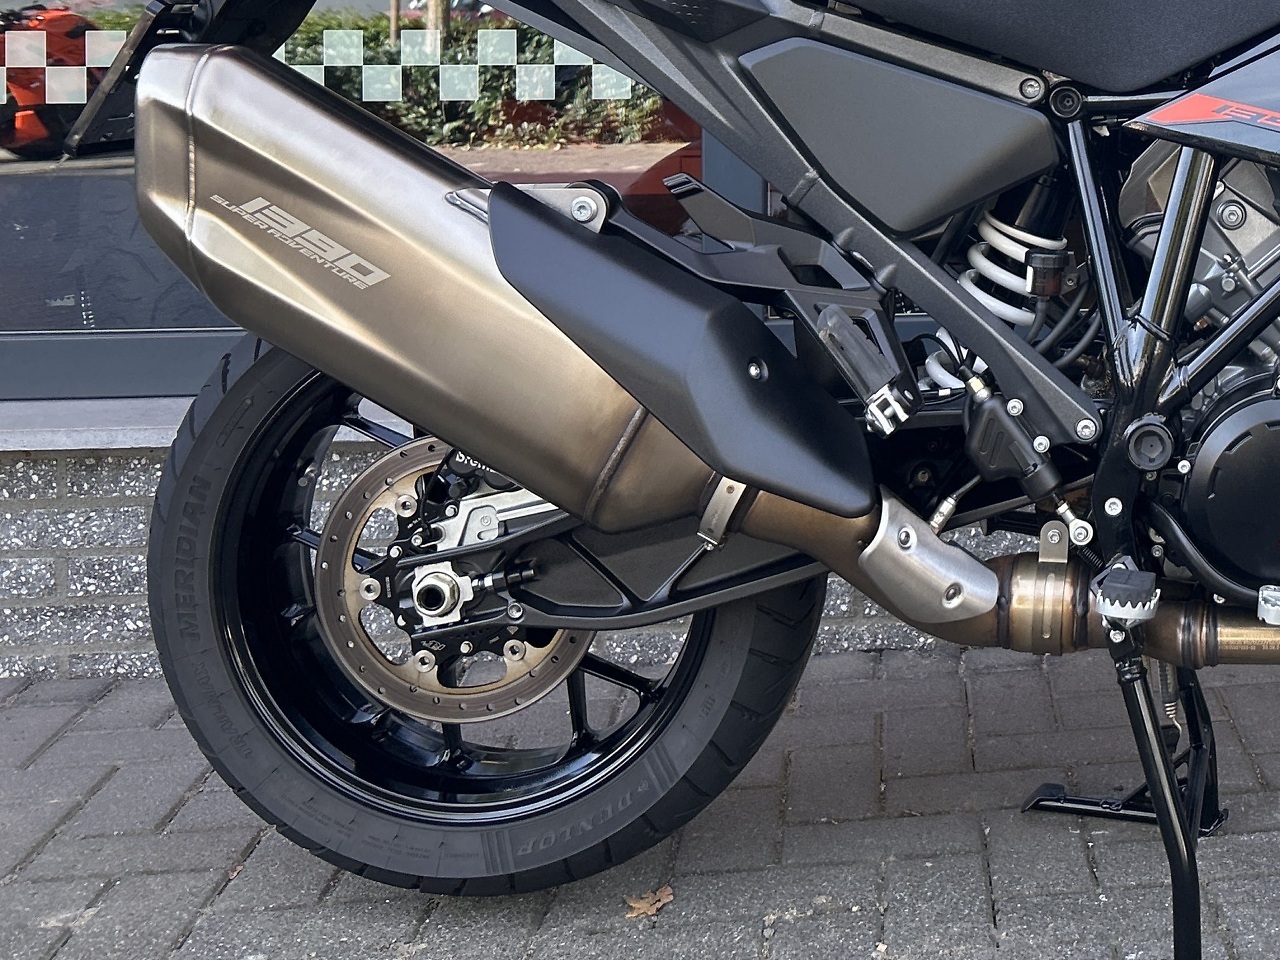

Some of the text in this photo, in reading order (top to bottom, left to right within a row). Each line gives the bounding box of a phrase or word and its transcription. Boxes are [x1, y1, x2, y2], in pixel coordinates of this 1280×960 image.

[210, 194, 369, 290] SUPER ADVENTURE
[239, 196, 392, 287] 1390
[173, 474, 213, 640] MERIDIAN
[514, 790, 634, 857] DUNLOP
